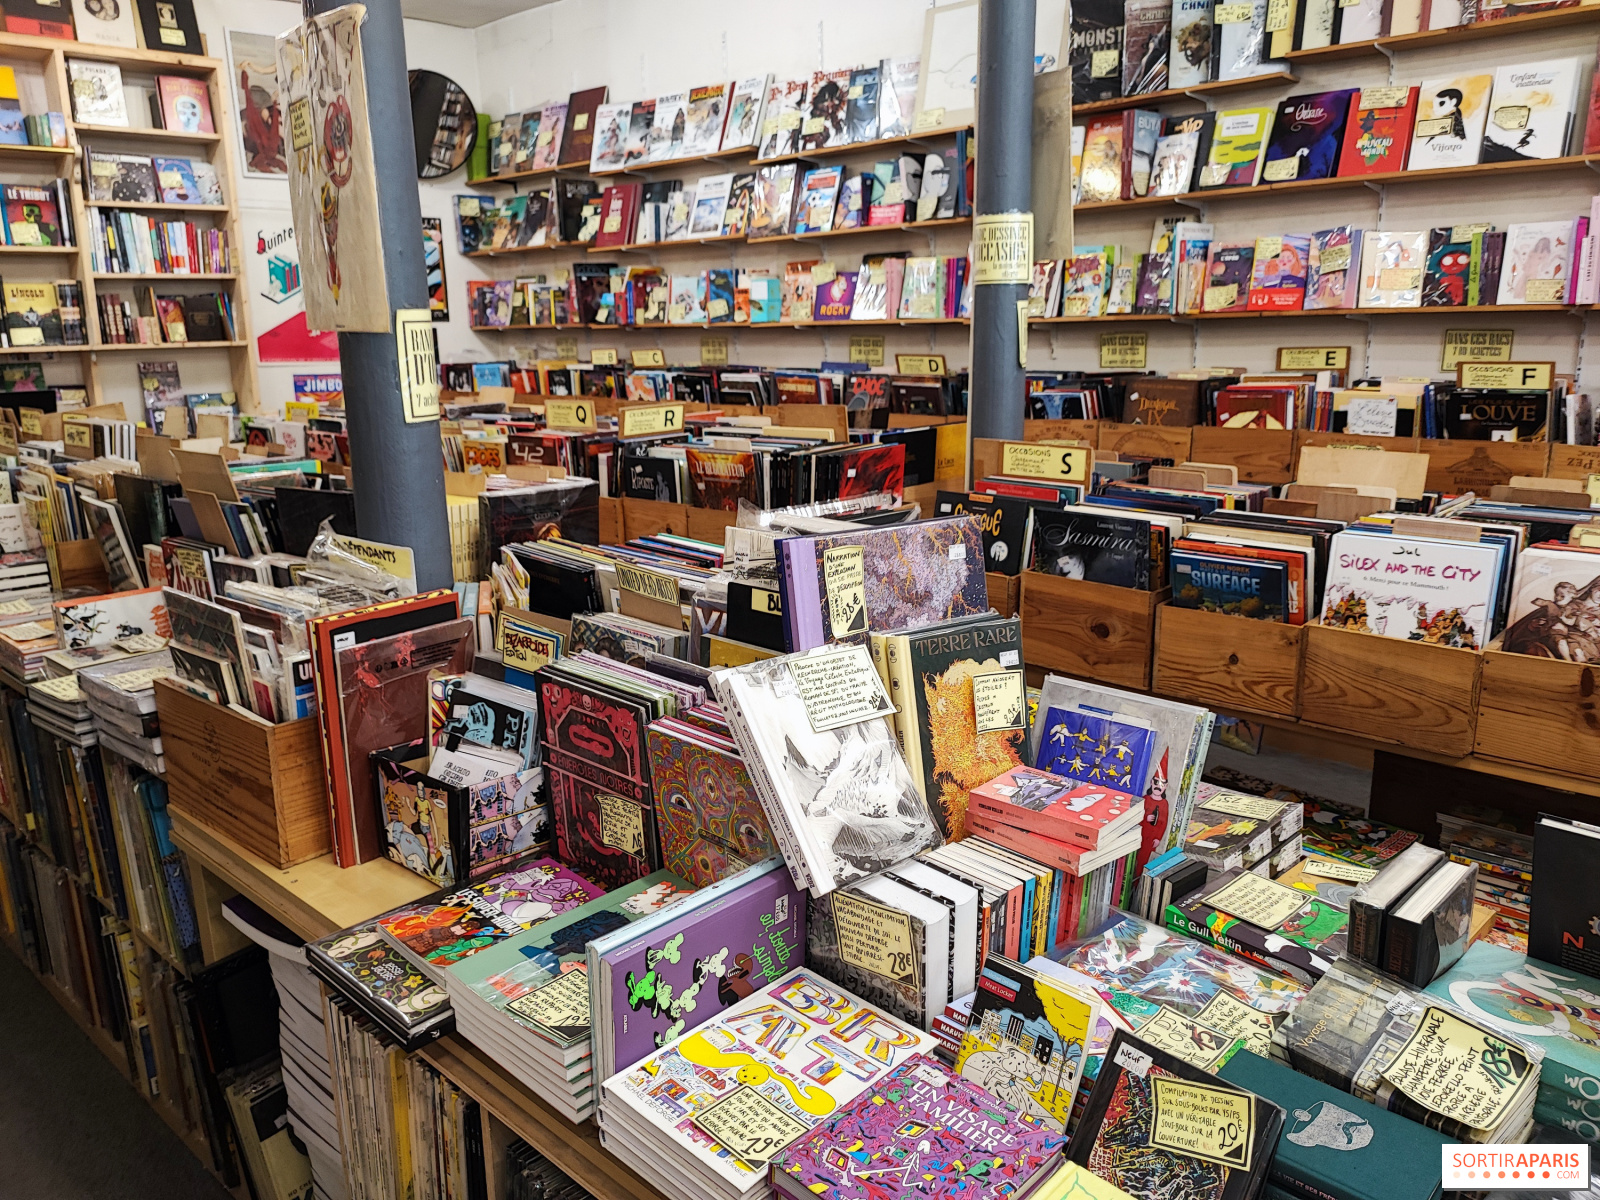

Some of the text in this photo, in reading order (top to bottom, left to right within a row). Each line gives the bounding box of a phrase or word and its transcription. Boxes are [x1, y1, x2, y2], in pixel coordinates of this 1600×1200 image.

[820, 304, 851, 316] ROCKY
[929, 359, 939, 372] D
[1325, 351, 1337, 366] E
[853, 377, 885, 395] CHOC
[1522, 368, 1537, 386] F
[576, 405, 587, 424] Q
[664, 410, 675, 427] R
[1461, 405, 1537, 421] LOUVE
[465, 450, 501, 467] PROFS
[514, 445, 545, 464] 42
[1009, 446, 1051, 457] OCCASIONS
[1061, 452, 1072, 475] S
[1042, 518, 1137, 551] Sasmira
[827, 551, 861, 563] NARRATION
[1392, 546, 1421, 557] Jul
[1199, 561, 1226, 570] OLIVIER
[1226, 565, 1250, 574] NOREK
[1385, 562, 1409, 574] AND
[1412, 564, 1436, 577] THE
[1191, 570, 1260, 595] SURFACE
[915, 625, 1018, 658] TERRE RARE
[805, 873, 815, 889] 2024
[839, 915, 872, 932] DÉCOUVERTE
[840, 925, 863, 938] NOUVEAU
[1173, 914, 1242, 953] Le Gull Yattin
[371, 965, 396, 981] JACOBS
[382, 961, 404, 975] JESSE
[887, 951, 912, 977] 28€
[997, 985, 1014, 999] Locker
[1297, 1019, 1327, 1047] Voyage
[1408, 1013, 1445, 1060] HIVERNALE
[1430, 1036, 1449, 1057] SUR
[621, 1080, 677, 1124] MICHAEL DEFORGE
[954, 1081, 1008, 1115] MICHAEL DEFORGE
[1160, 1083, 1234, 1107] COMPILATION DE DESSINS
[741, 1090, 755, 1100] UNE
[753, 1097, 778, 1118] CRITIQUE
[790, 1126, 802, 1134] ET
[911, 1079, 1019, 1147] UN VISAGE
[1162, 1097, 1174, 1105] SUR
[1209, 1106, 1221, 1116] PAR
[907, 1093, 1001, 1150] FAMILIER
[1161, 1108, 1174, 1118] AVEC
[1185, 1112, 1216, 1127] VÉRITABLE
[1191, 1127, 1203, 1136] SUR
[1206, 1129, 1213, 1139] LA
[740, 1136, 785, 1155] 19€
[723, 1159, 748, 1178] ATRABILE
[1295, 1179, 1305, 1187] ET
[1304, 1184, 1318, 1195] SES
